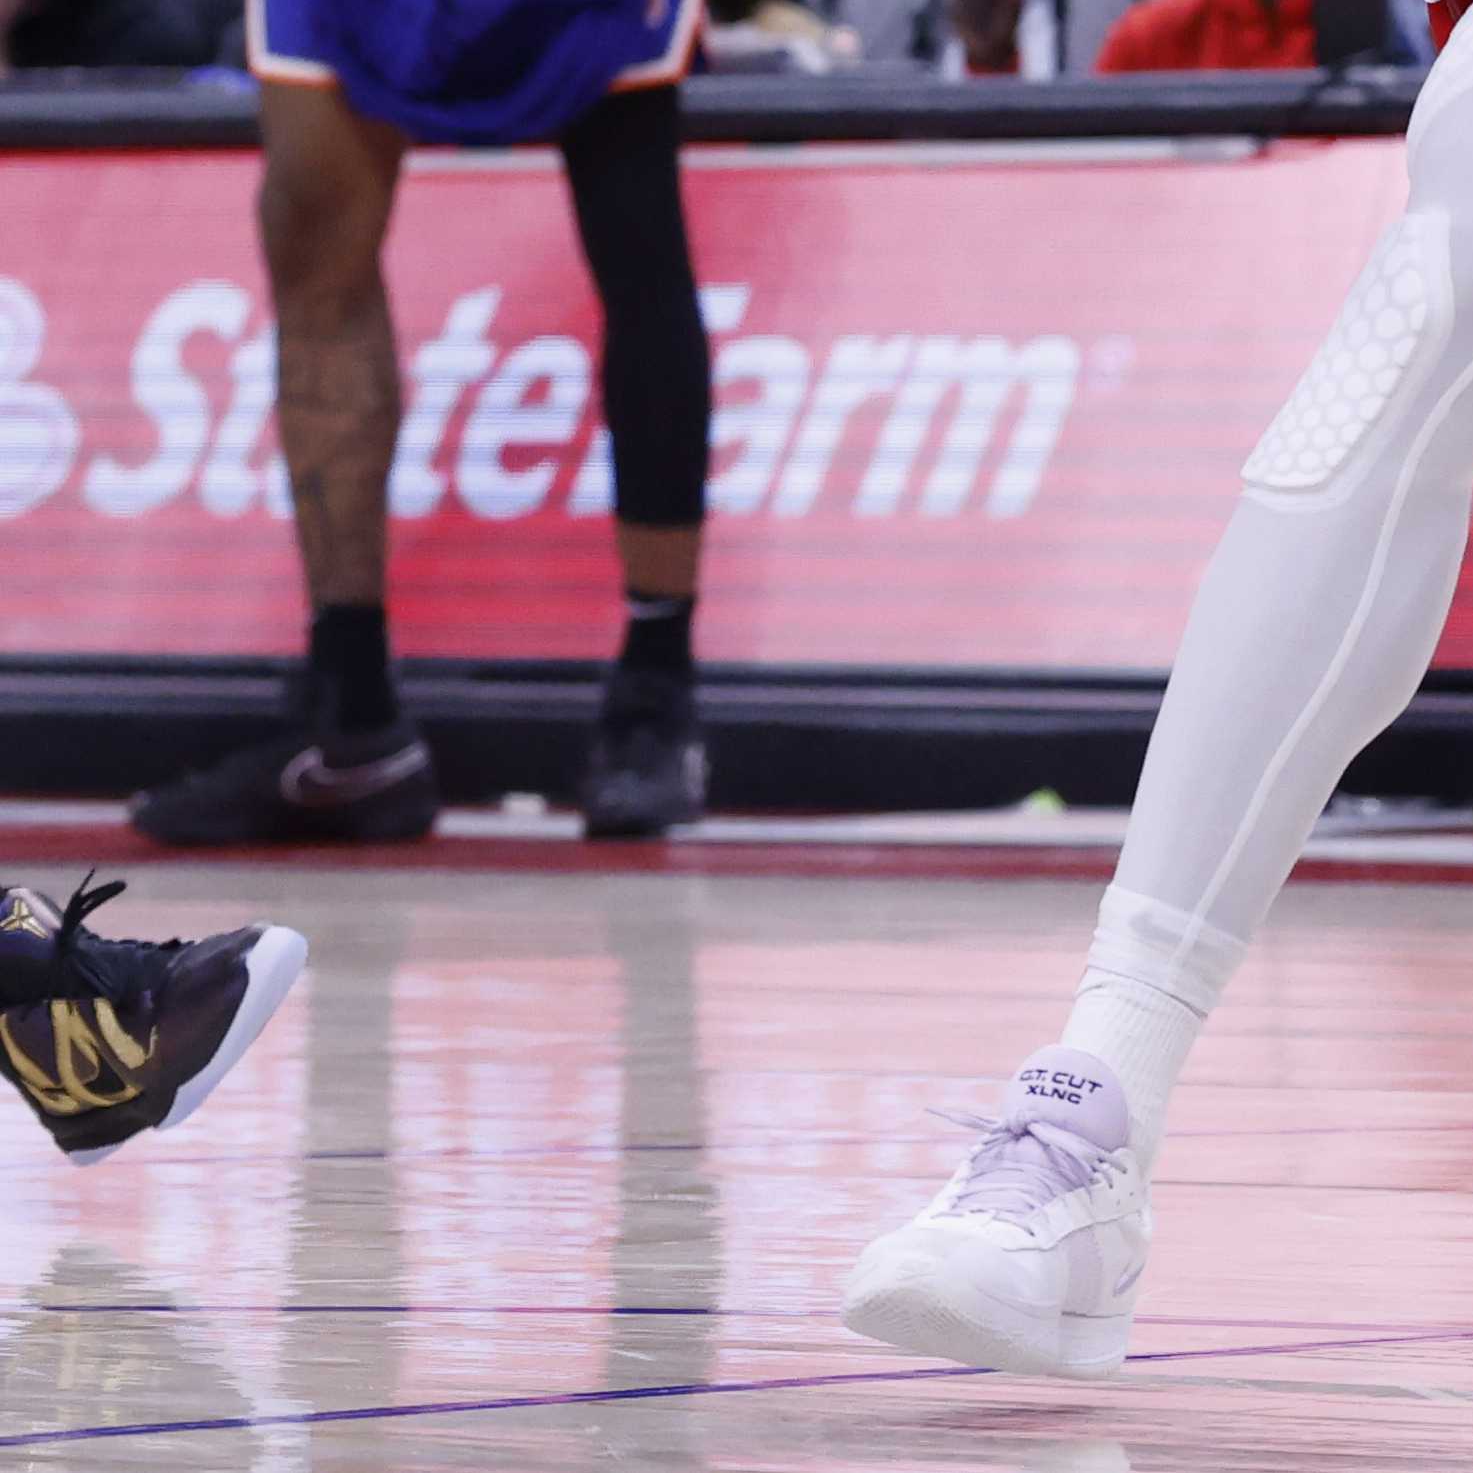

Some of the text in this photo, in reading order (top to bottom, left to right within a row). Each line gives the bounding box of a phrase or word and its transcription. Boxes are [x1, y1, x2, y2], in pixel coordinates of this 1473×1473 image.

[84, 277, 1082, 521] Stte arm
[1052, 1072, 1103, 1093] CUT
[1025, 1085, 1082, 1105] XLNC
